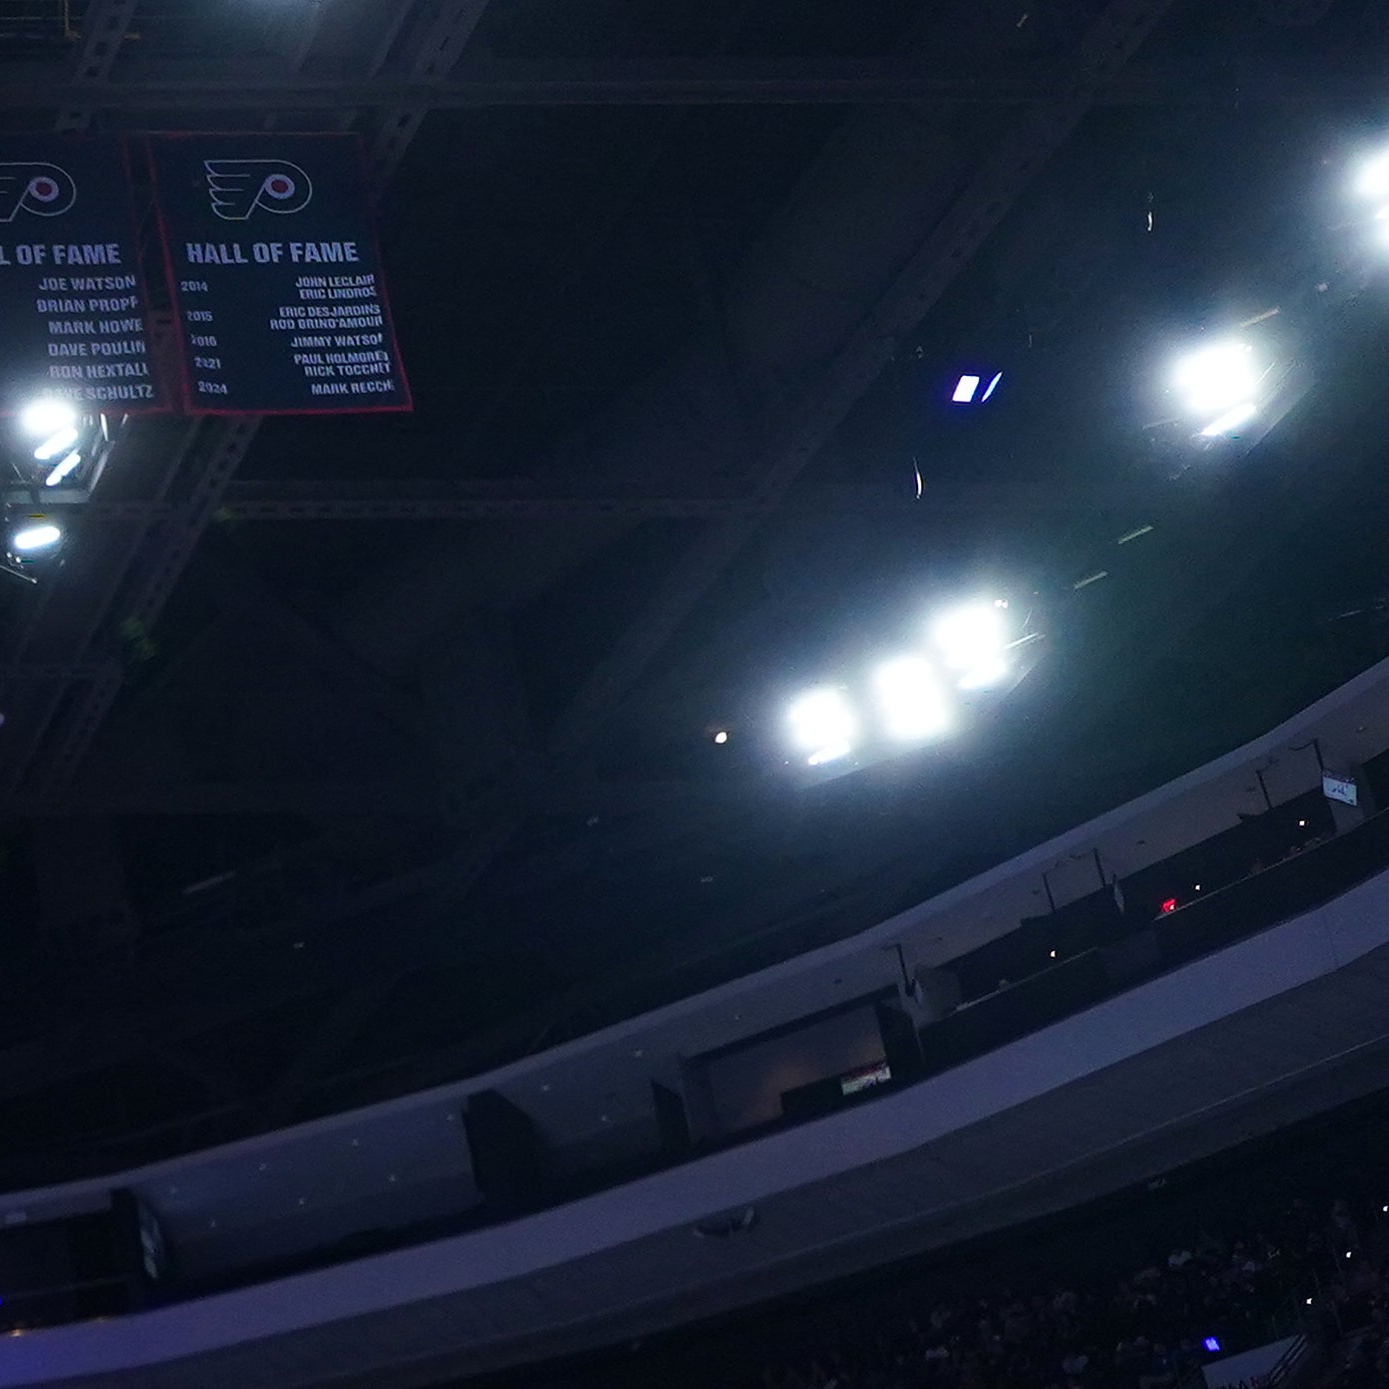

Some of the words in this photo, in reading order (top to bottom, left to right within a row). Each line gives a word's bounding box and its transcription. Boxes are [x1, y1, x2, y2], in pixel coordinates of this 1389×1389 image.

[15, 244, 46, 265] OF
[52, 243, 122, 265] FAME
[186, 243, 248, 264] HALL
[252, 243, 283, 263] OF
[289, 242, 359, 263] FAME
[39, 277, 69, 291] JOE
[73, 274, 136, 291] WATSON
[180, 280, 208, 292] 2014
[295, 275, 326, 288] JOHN
[328, 274, 374, 287] LECLAIR
[299, 288, 326, 300] ERIC
[328, 286, 377, 299] LINDROS
[37, 299, 86, 313] BRIAN
[279, 307, 306, 318] ERIC
[308, 303, 381, 317] DESJARDINS
[48, 321, 96, 334] MARK
[99, 318, 143, 333] HOWE
[270, 319, 295, 330] ROD
[48, 343, 87, 356] DAVE
[91, 340, 146, 356] POULIN
[291, 336, 332, 348] JIMMY
[336, 333, 383, 346] WATSON
[294, 353, 323, 365] PAUL
[49, 365, 82, 379] RON
[86, 362, 150, 378] HEXTALL
[305, 365, 334, 376] RICK
[337, 363, 392, 375] TOCCHET
[87, 384, 153, 400] SCHULTZ
[311, 384, 350, 395] MARK
